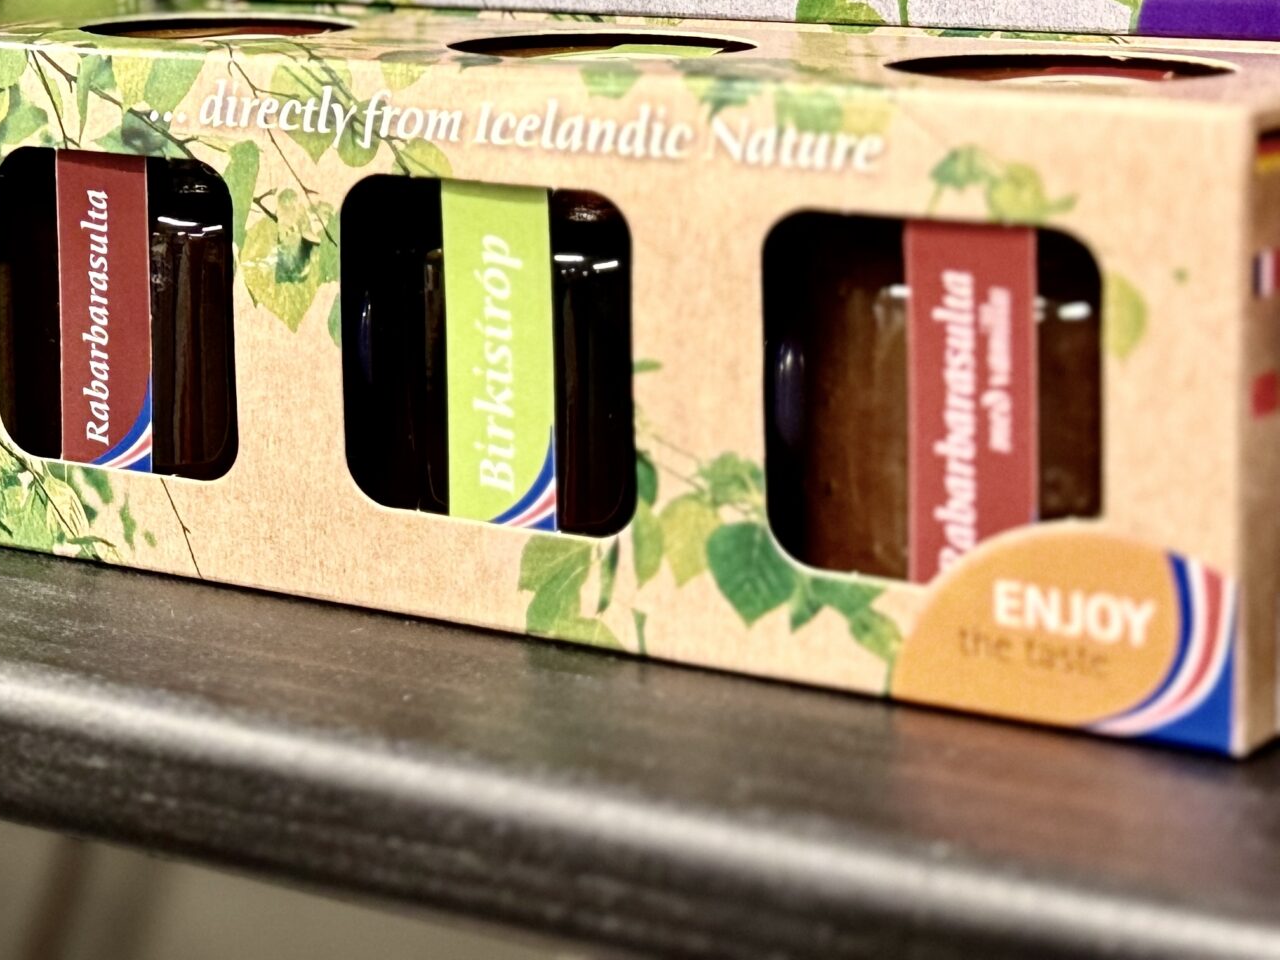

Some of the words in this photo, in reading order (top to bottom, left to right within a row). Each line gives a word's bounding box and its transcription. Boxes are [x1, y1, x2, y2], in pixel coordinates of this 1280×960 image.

[198, 80, 357, 142] directly
[360, 90, 461, 148] from
[475, 100, 693, 160] Icelandic
[702, 112, 884, 171] Nature
[80, 188, 111, 447] Rabarbarasulta
[472, 235, 524, 496] Birkisíróp
[958, 625, 1015, 665] the
[1021, 632, 1113, 680] taste
[993, 580, 1158, 647] ENJOY
